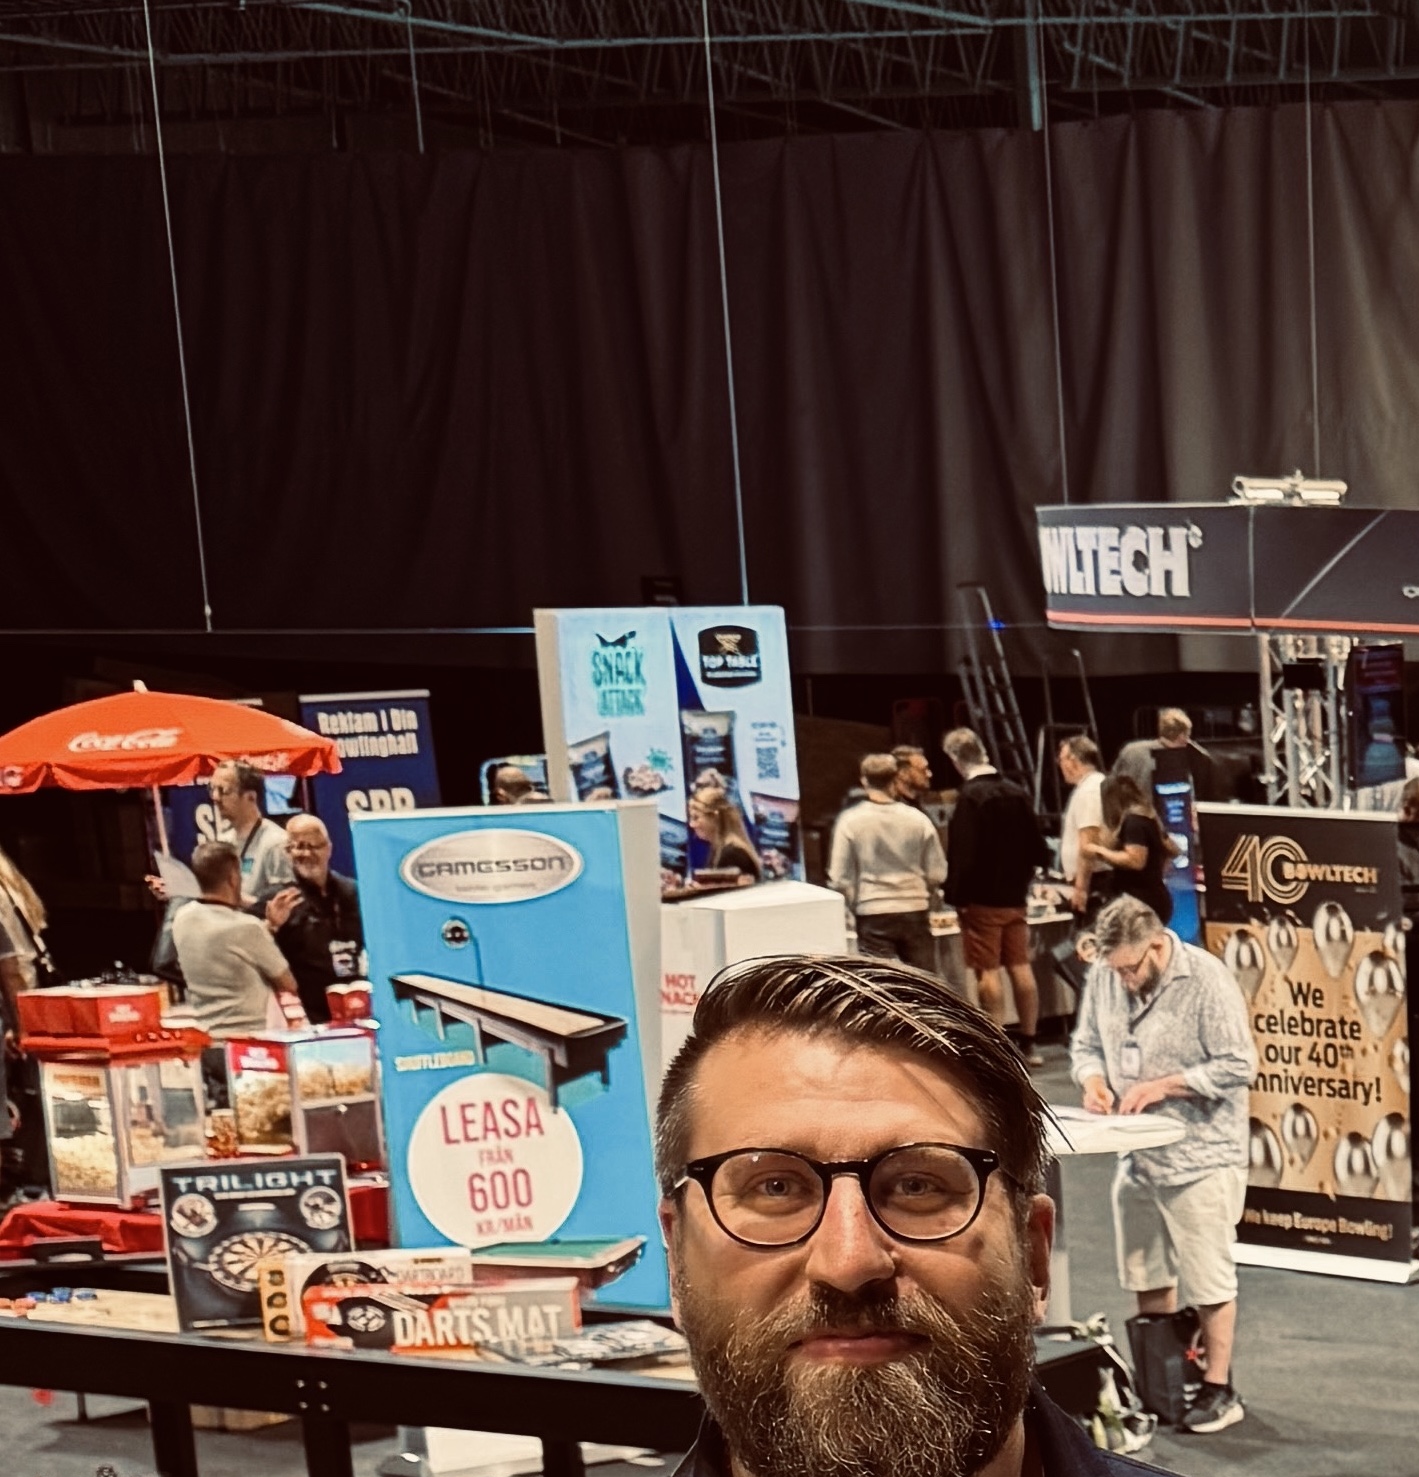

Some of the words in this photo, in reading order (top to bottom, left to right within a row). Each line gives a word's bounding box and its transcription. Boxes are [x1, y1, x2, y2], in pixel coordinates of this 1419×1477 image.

[1041, 526, 1191, 597] WLTECH
[592, 649, 647, 686] SNACK
[702, 655, 724, 669] TOP
[726, 655, 758, 669] TABLE
[317, 708, 379, 736] Reklam
[68, 728, 184, 752] Coca-Cola
[337, 732, 419, 759] owlinghall
[418, 855, 567, 879] GAMESSON
[1283, 861, 1378, 884] BOWLTECH
[665, 973, 697, 990] HOT
[1287, 980, 1325, 1010] We
[1253, 1009, 1362, 1042] celebrate
[1264, 1045, 1303, 1066] our
[440, 1096, 545, 1145] LEASA
[478, 1145, 515, 1167] FRÅN
[171, 1167, 338, 1194] TRILIGHT
[467, 1167, 534, 1214] 600
[393, 1307, 493, 1347] DARTS
[495, 1303, 563, 1349] MAT
